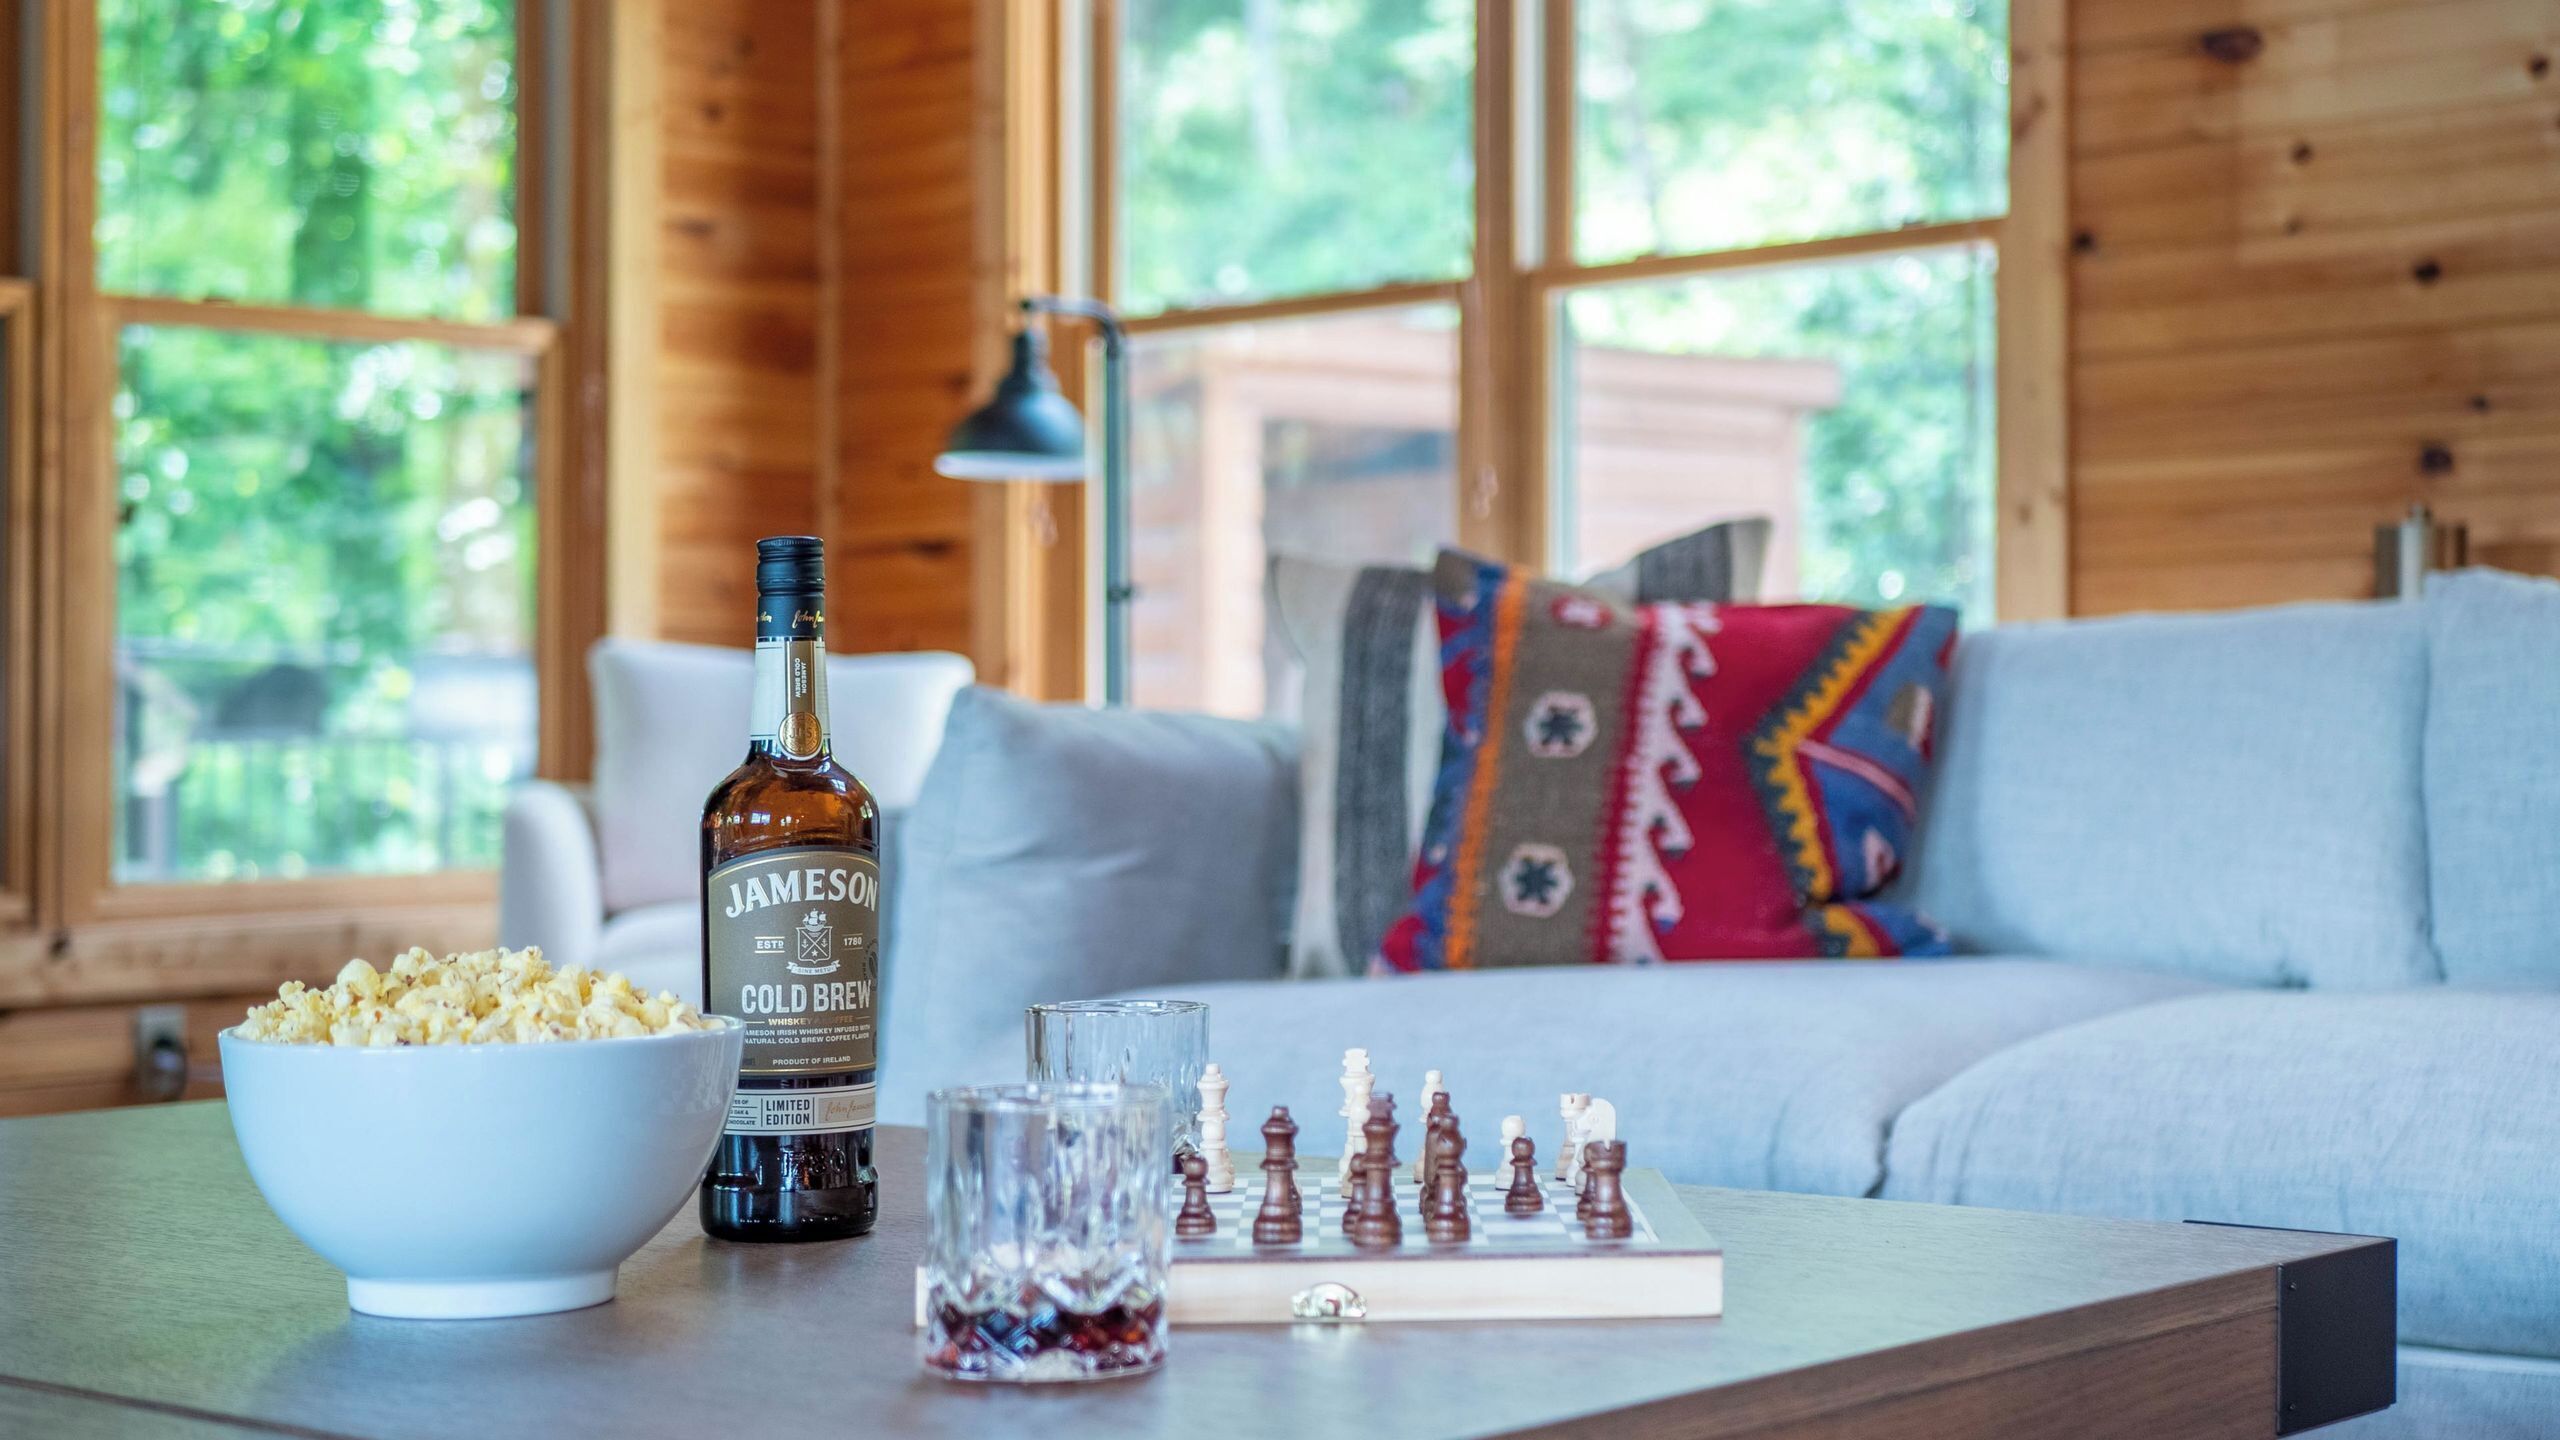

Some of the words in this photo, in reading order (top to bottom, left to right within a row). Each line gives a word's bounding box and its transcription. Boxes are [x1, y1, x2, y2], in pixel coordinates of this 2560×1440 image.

[725, 868, 878, 918] JAMESON
[843, 936, 863, 946] 1780
[741, 984, 808, 1014] COLD
[813, 979, 872, 1012] BREW
[768, 1017, 812, 1026] WHISKEY
[744, 1029, 775, 1037] AMESON
[799, 1027, 834, 1036] WHISKEY
[834, 1025, 859, 1033] INFUSED
[801, 1036, 824, 1044] BREW
[825, 1034, 851, 1042] COFFEE
[772, 1058, 810, 1066] PRODUCT
[822, 1055, 852, 1063] IRELAND
[766, 1099, 811, 1112] LIMITED
[766, 1113, 811, 1126] EDITION
